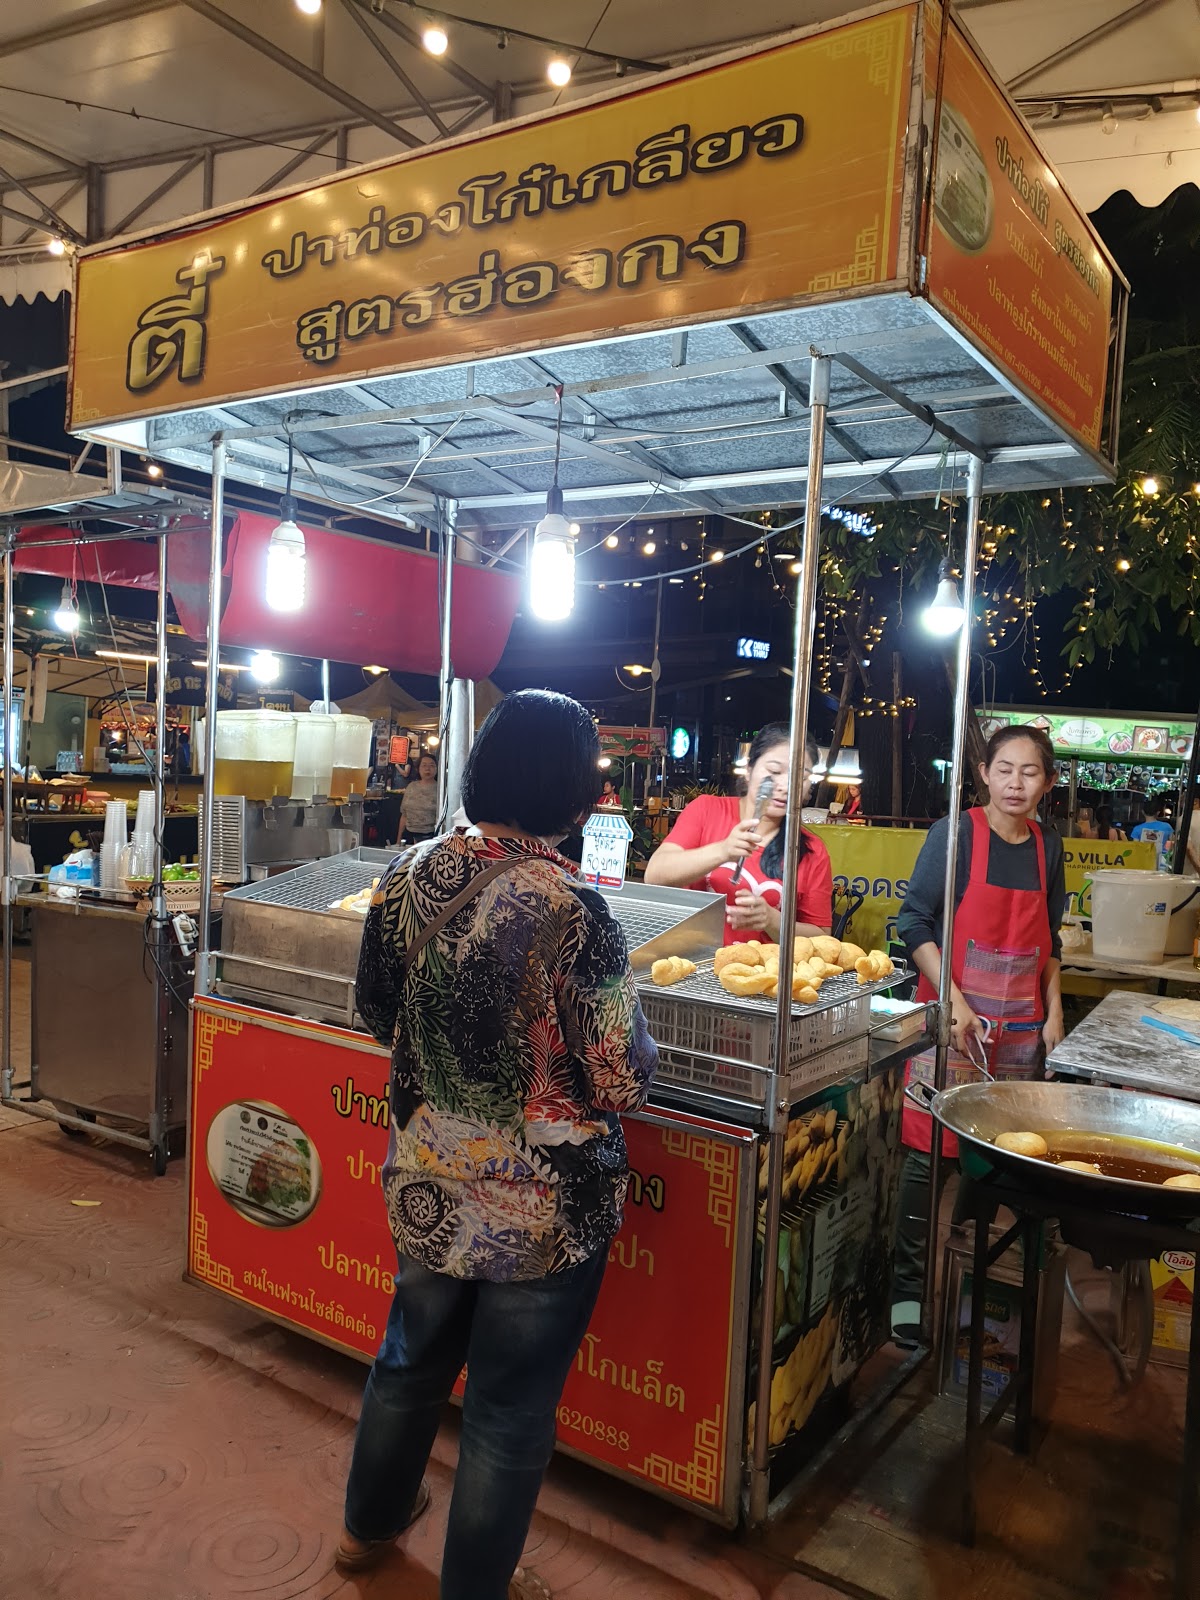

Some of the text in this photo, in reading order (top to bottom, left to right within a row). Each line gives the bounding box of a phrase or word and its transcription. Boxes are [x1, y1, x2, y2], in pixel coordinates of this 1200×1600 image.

[262, 113, 804, 278] ปาท่องโก๋เกลียว
[996, 136, 1050, 229] ปาท่องโก๋
[296, 220, 746, 363] สูตรฮ่องกง
[126, 247, 225, 393] ตี๋
[753, 641, 770, 651] DRIVE
[753, 649, 769, 659] THRU
[1078, 852, 1125, 867] VILLA
[346, 1149, 384, 1188] ปา
[556, 1404, 630, 1452] 620888
